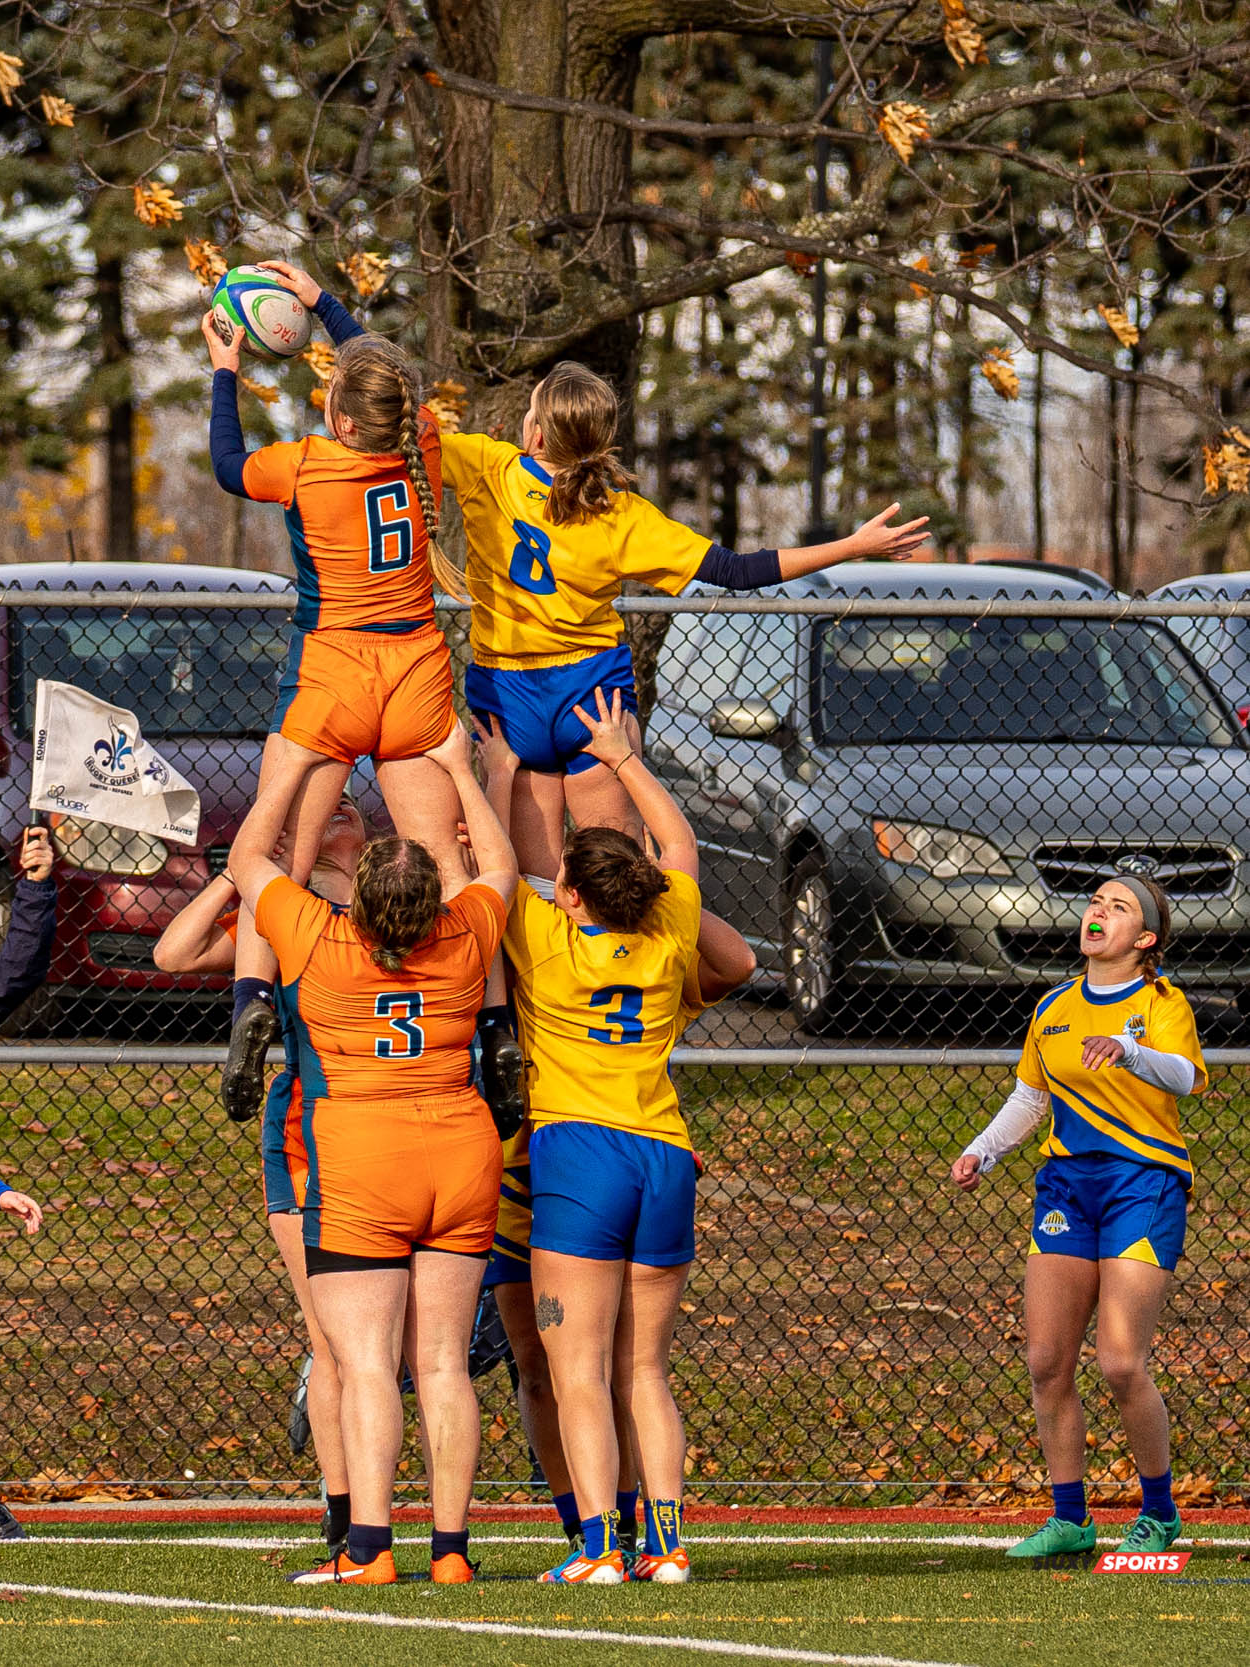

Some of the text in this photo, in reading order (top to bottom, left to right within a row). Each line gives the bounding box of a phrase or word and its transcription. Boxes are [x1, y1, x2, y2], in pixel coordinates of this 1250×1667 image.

[365, 480, 414, 575] 6
[509, 518, 558, 595] 8
[374, 991, 425, 1059] 3
[587, 984, 645, 1045] 3
